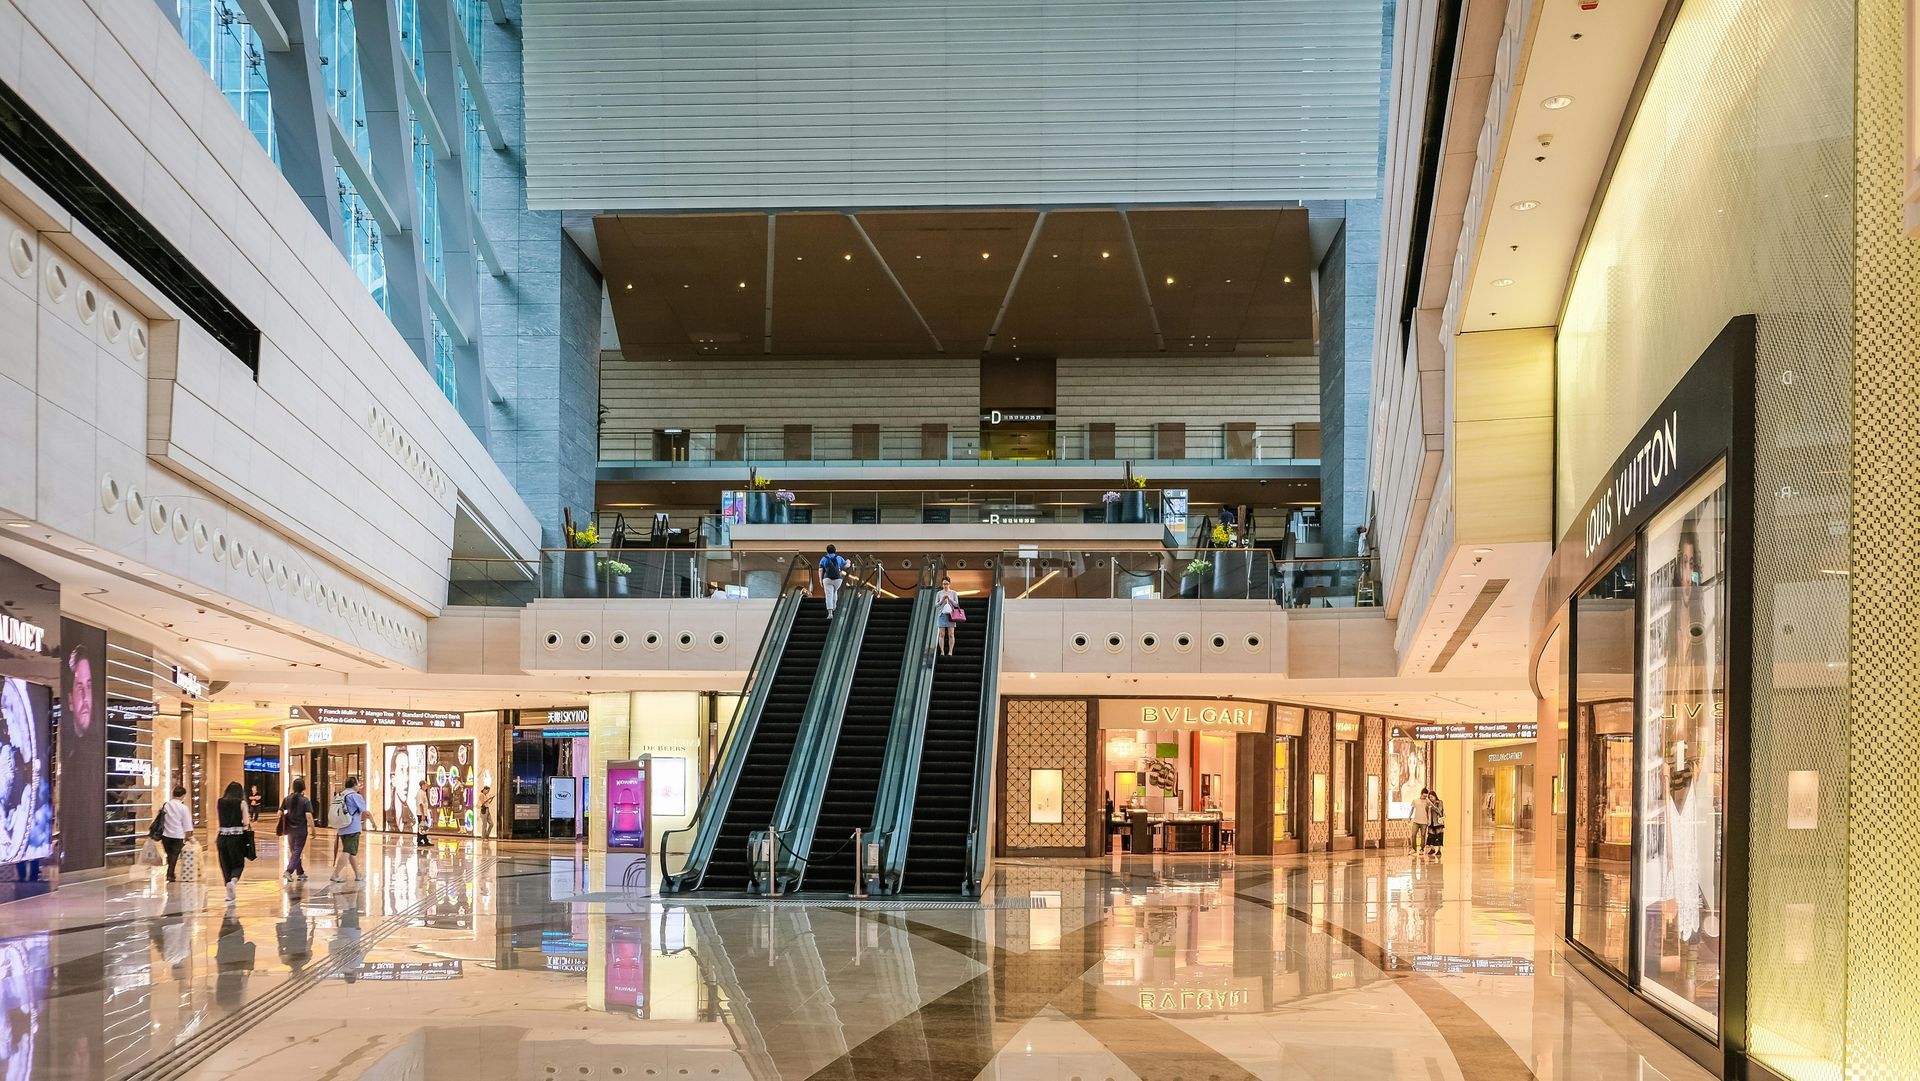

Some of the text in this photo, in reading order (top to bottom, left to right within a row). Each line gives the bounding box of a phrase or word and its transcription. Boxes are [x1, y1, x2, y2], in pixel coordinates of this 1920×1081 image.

[991, 410, 1002, 424] D
[1585, 409, 1677, 559] LOUIS VUITTON
[990, 514, 1000, 524] R
[0, 613, 45, 652] UMET
[365, 710, 383, 718] Mango
[563, 710, 587, 722] SKY100
[1142, 706, 1253, 725] BVLGARI
